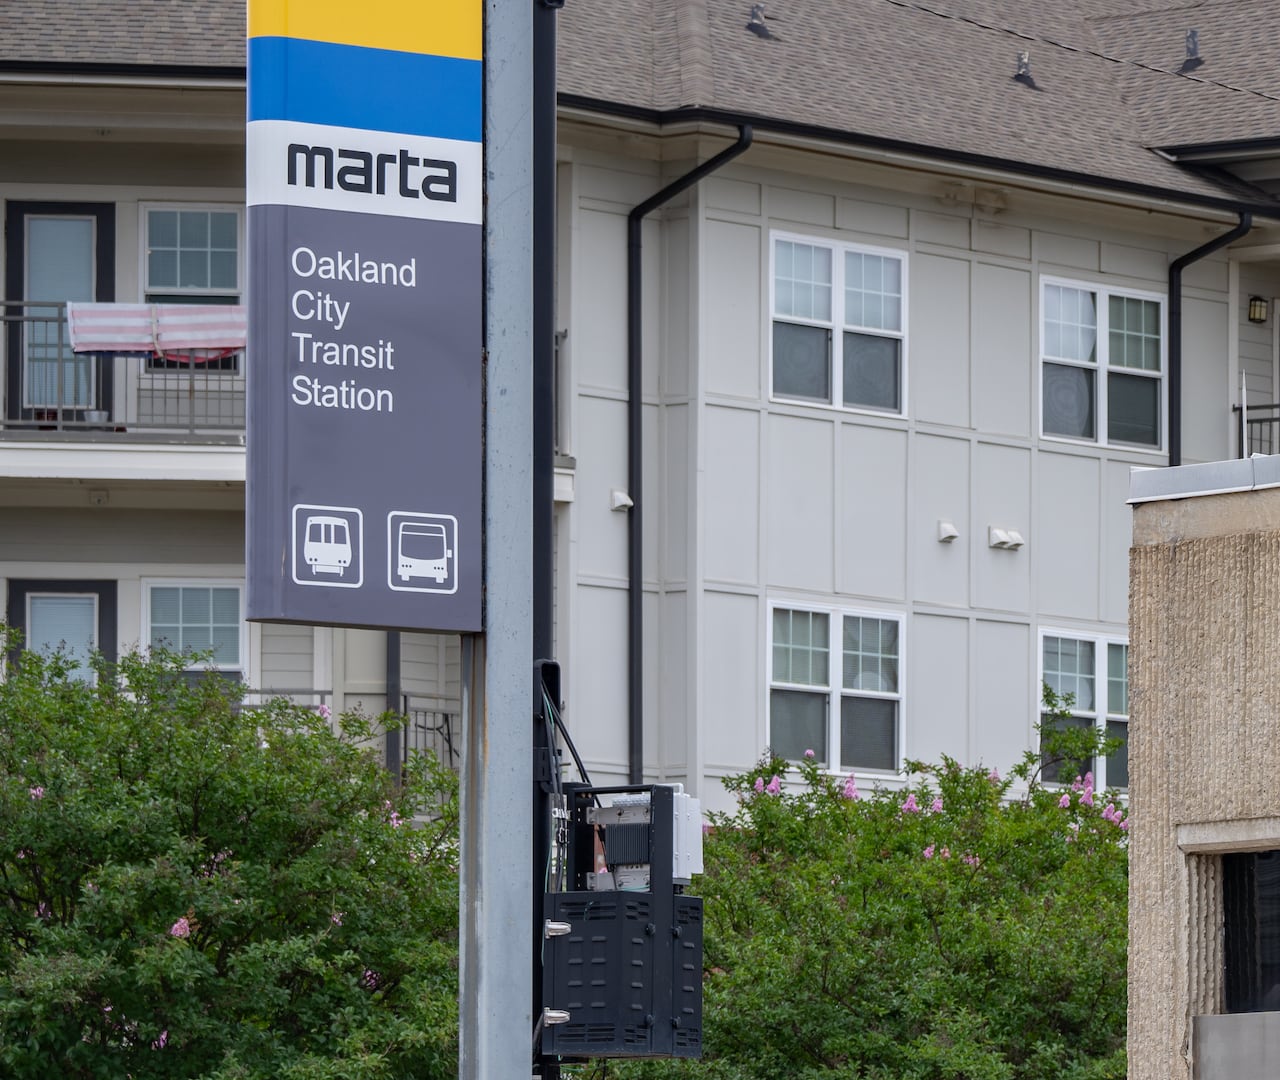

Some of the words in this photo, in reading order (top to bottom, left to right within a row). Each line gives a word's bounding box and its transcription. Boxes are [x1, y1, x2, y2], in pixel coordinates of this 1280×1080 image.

[287, 143, 457, 203] marta
[291, 246, 417, 288] Oakland
[291, 290, 350, 330] City
[291, 332, 394, 371] Transit
[291, 375, 393, 413] Station
